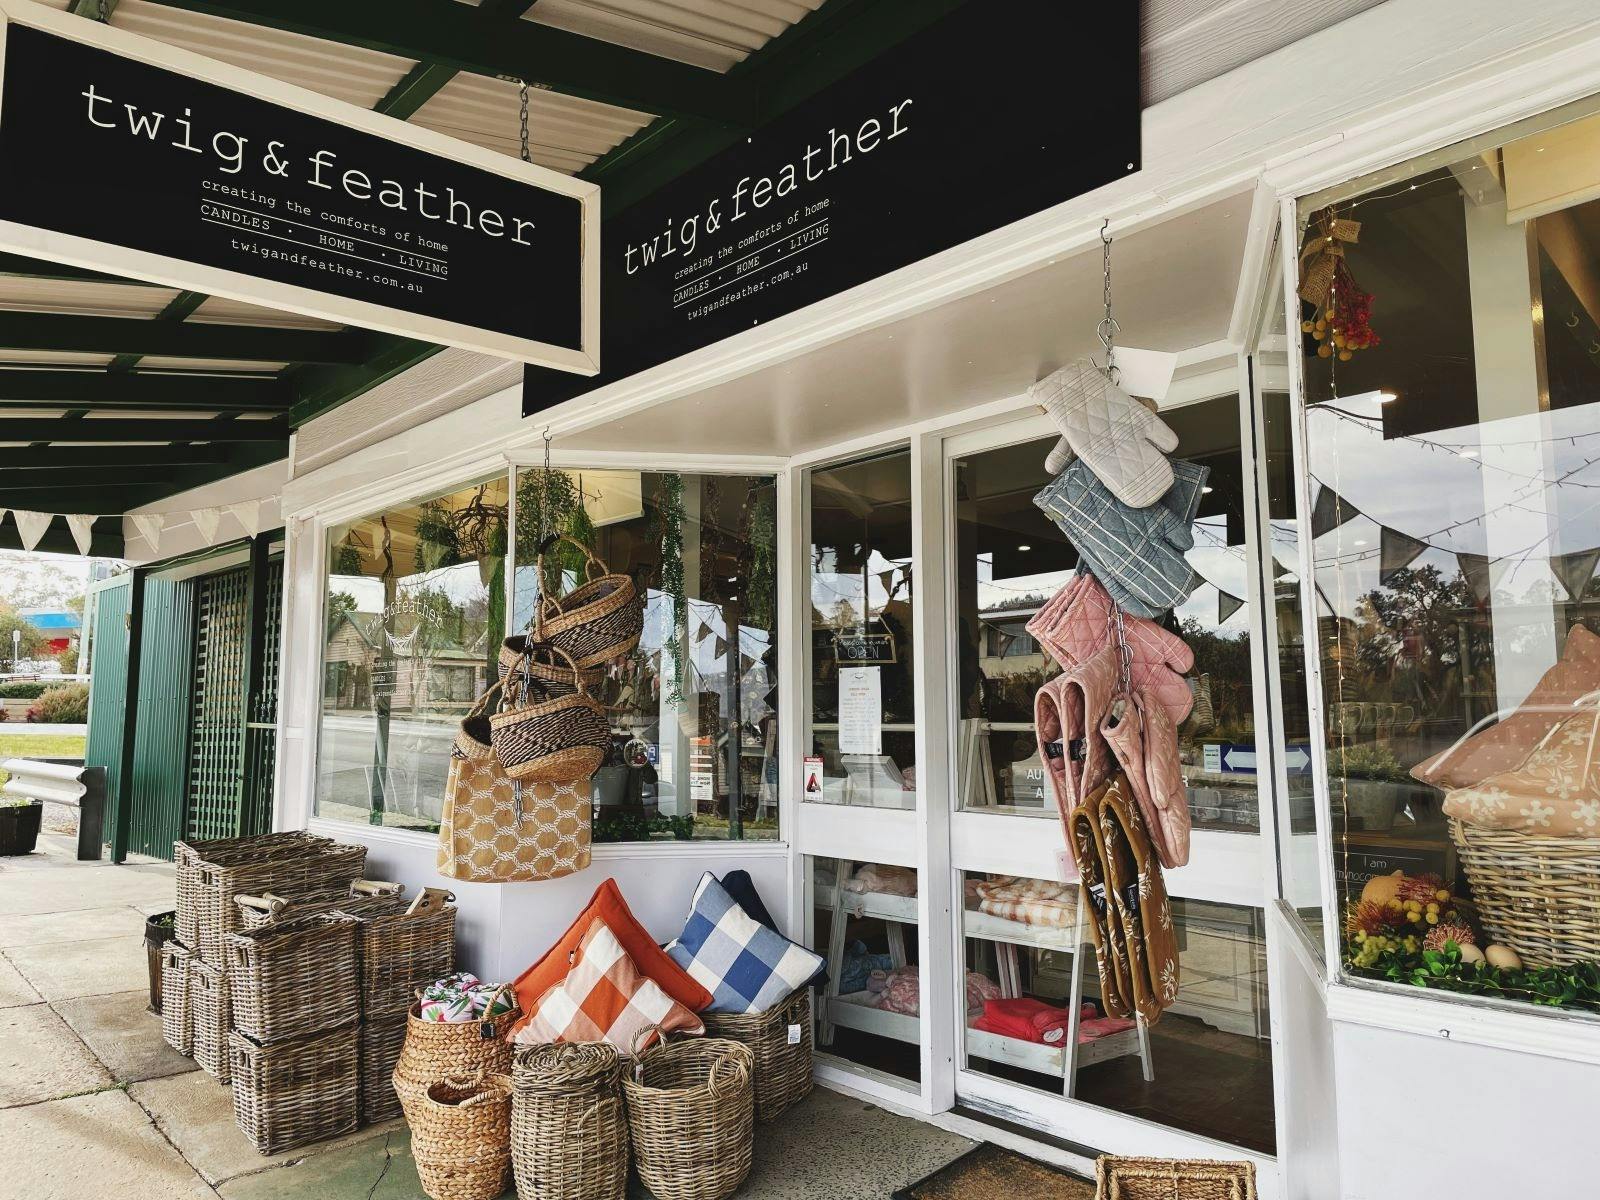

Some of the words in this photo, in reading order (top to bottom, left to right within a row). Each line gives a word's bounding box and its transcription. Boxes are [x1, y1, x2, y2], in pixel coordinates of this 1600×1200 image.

[200, 204, 270, 231] CANDLES
[319, 234, 355, 252] HOME
[399, 254, 448, 276] LIVING
[202, 179, 276, 208] creating
[286, 199, 312, 217] the
[320, 209, 387, 237] comforts
[394, 229, 411, 242] of
[417, 234, 449, 252] home
[674, 254, 713, 280] creating
[717, 244, 733, 259] the
[738, 222, 782, 249] comforts
[787, 210, 800, 225] of
[804, 198, 830, 218] home
[231, 237, 424, 294] twigandfeather.com.au
[673, 279, 709, 303] CANDLES
[736, 255, 760, 275] HOME
[790, 223, 829, 250] LIVING
[687, 261, 808, 321] twigandfeather.com.au
[1369, 859, 1387, 868] am
